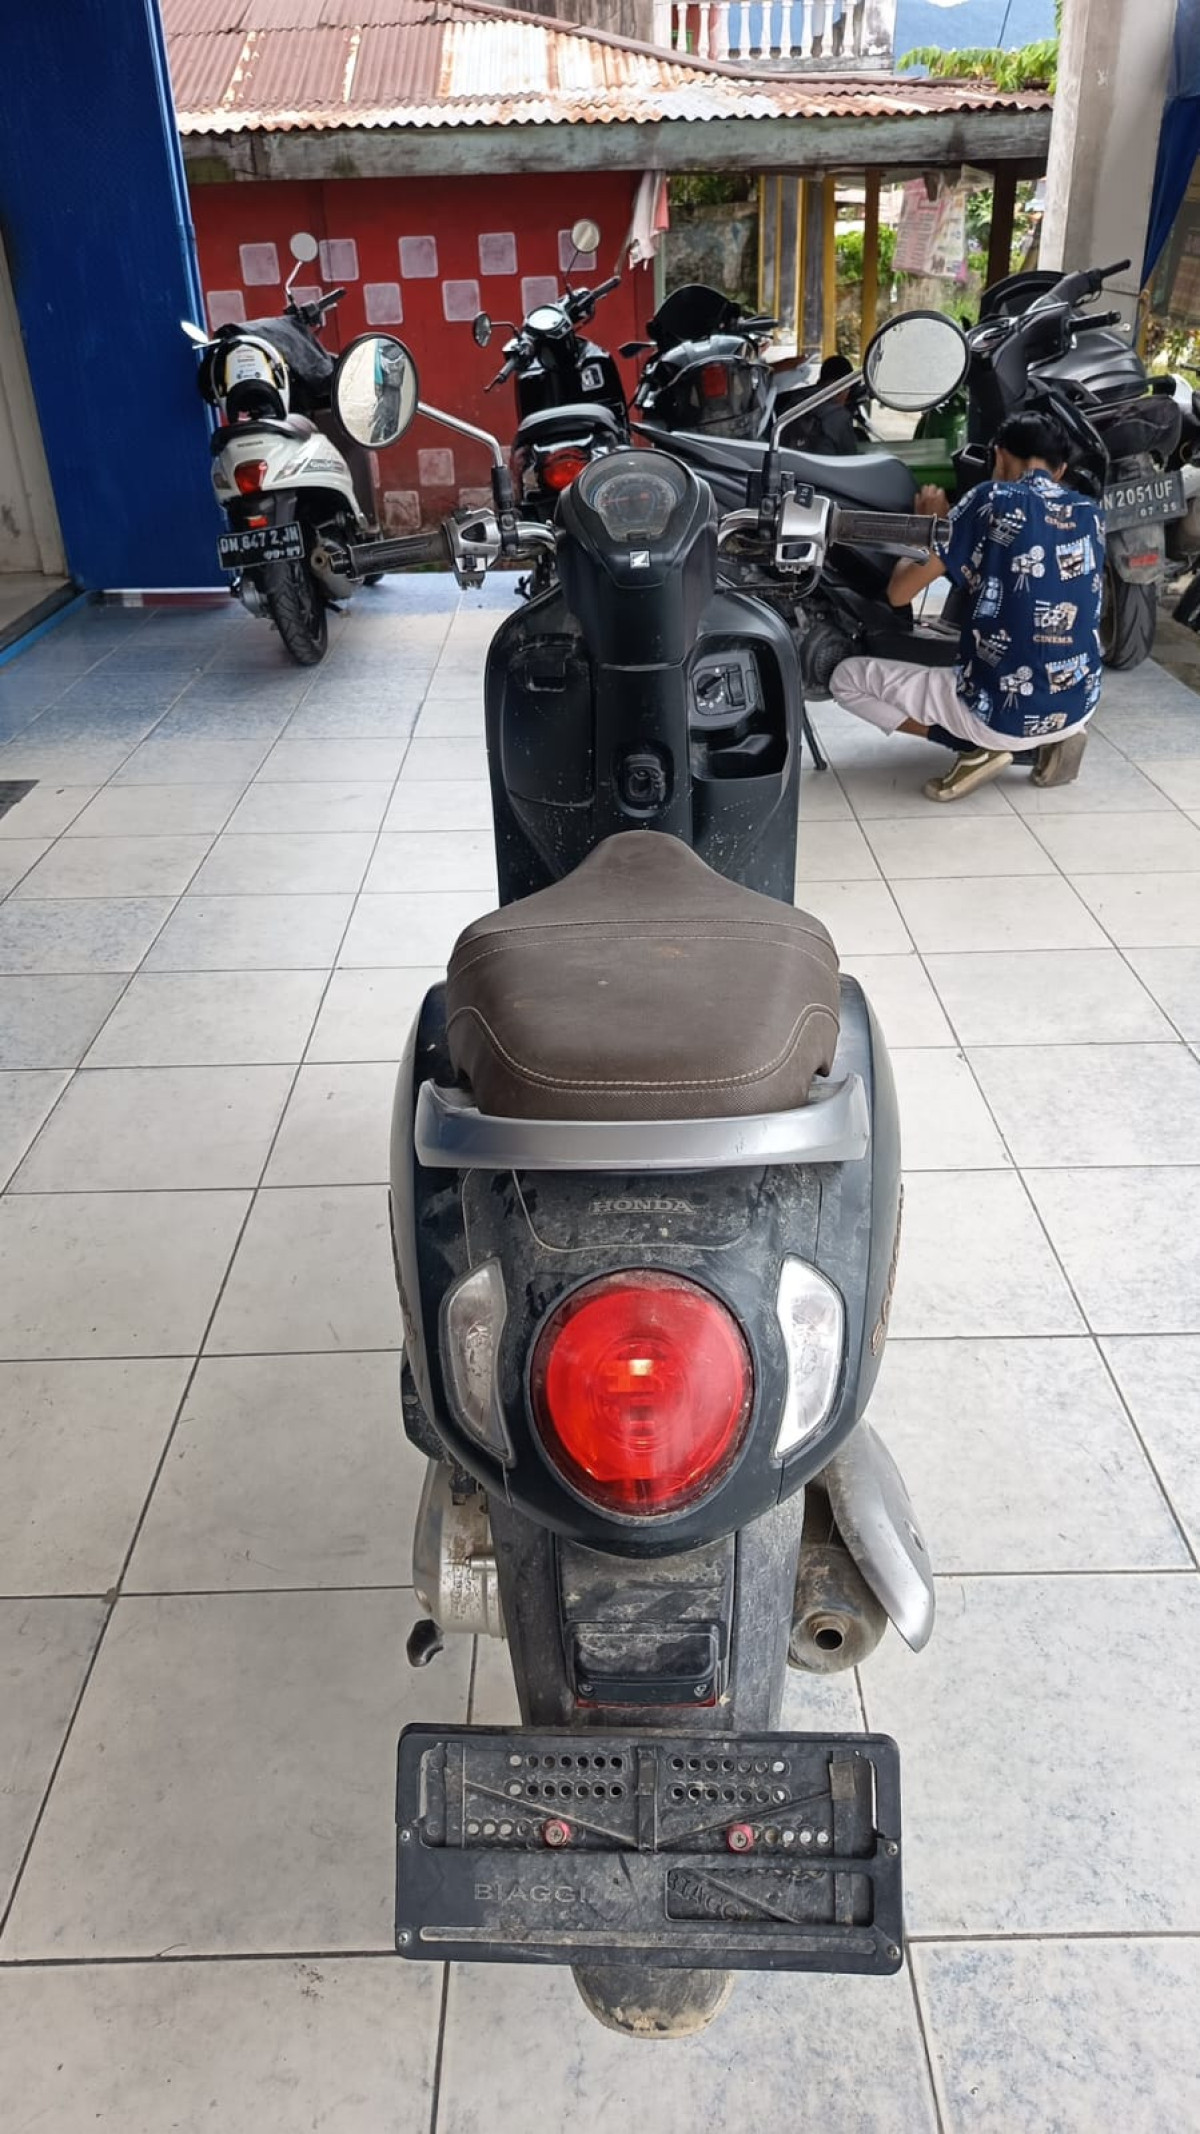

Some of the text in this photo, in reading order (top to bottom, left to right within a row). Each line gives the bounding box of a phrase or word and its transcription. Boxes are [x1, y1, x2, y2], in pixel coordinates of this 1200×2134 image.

[1032, 634, 1073, 644] CINEMA
[590, 1198, 695, 1214] HONDA
[474, 1883, 586, 1903] BIAGGI
